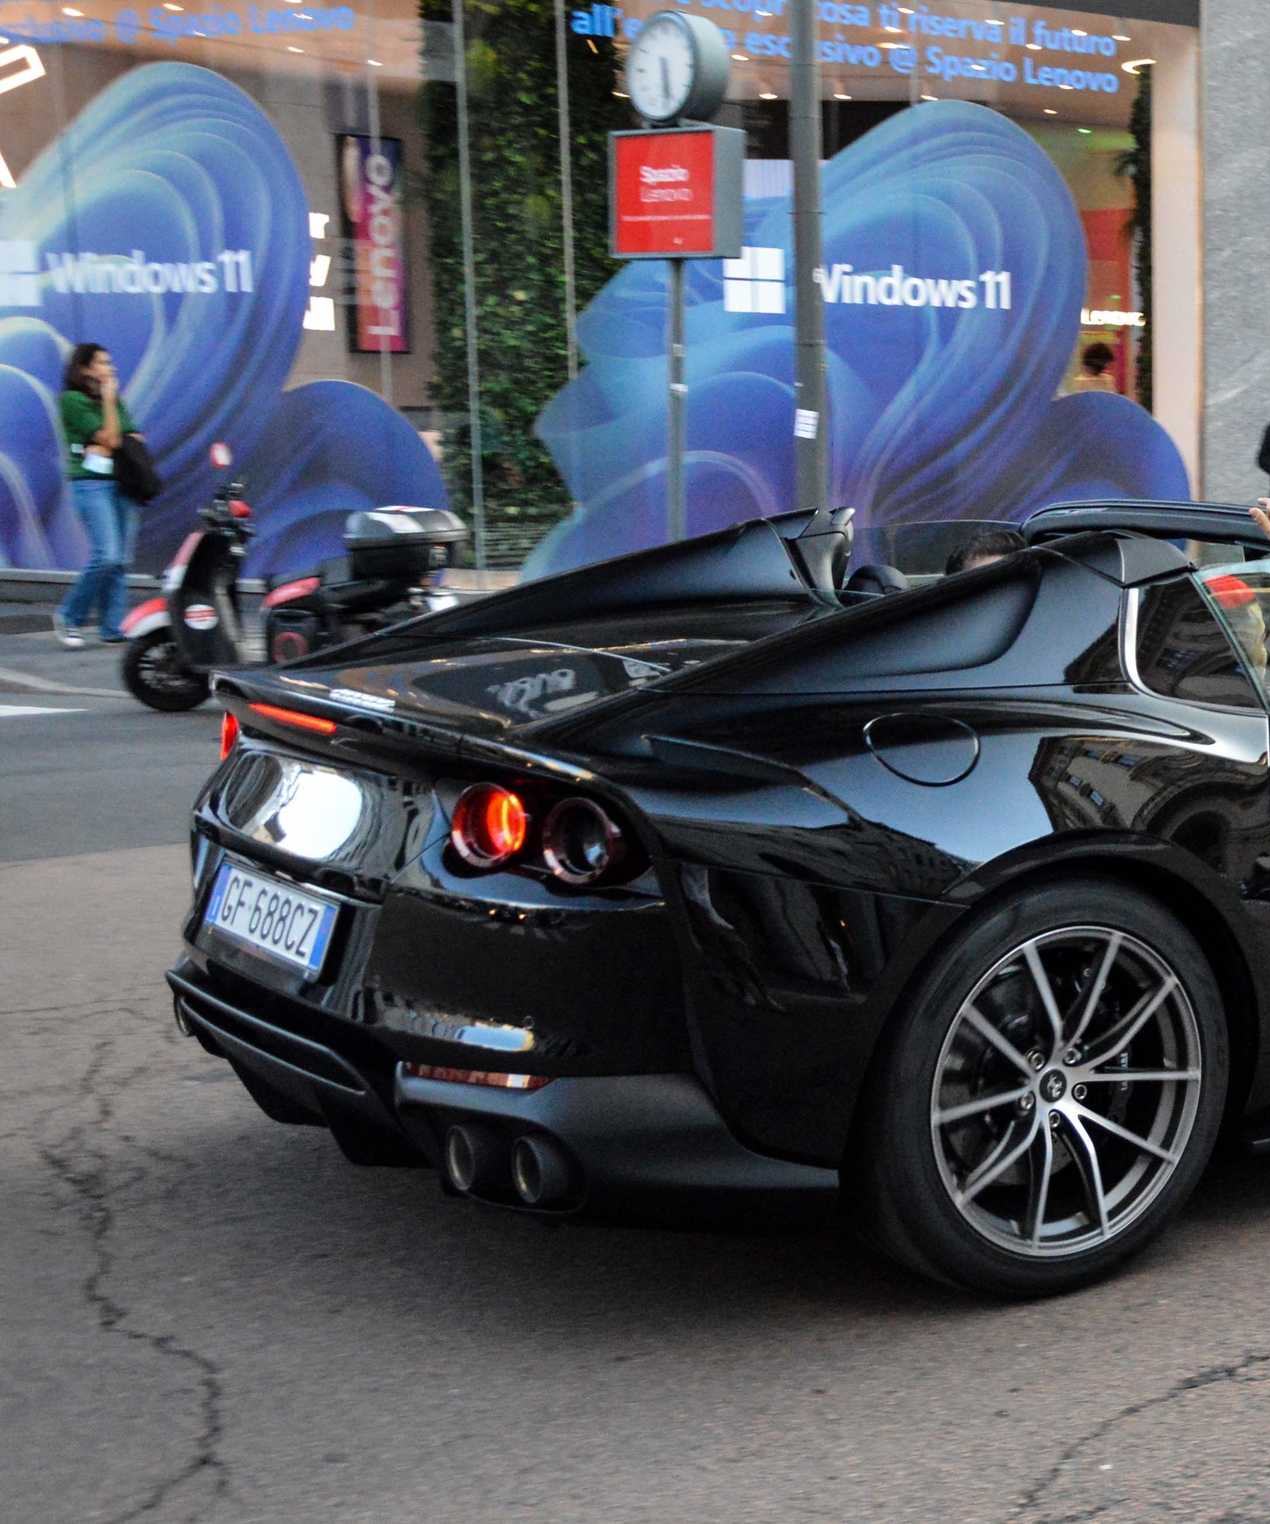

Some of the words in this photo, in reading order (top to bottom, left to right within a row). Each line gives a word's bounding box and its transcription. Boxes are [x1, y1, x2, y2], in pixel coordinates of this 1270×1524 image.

[816, 0, 871, 27] osa
[878, 2, 900, 31] ti
[908, 5, 1002, 43] riserva
[1008, 17, 1027, 46] il
[1031, 19, 1117, 57] futuro
[889, 42, 918, 74] @
[925, 45, 1018, 82] Spazio
[1023, 56, 1120, 93] Lenovo
[639, 164, 690, 185] Spazio
[365, 154, 401, 337] Lenovo
[46, 250, 219, 294] Windows
[217, 249, 254, 293] 11
[979, 270, 1012, 310] 11
[221, 875, 253, 926] GF
[248, 887, 319, 958] 688CZ
